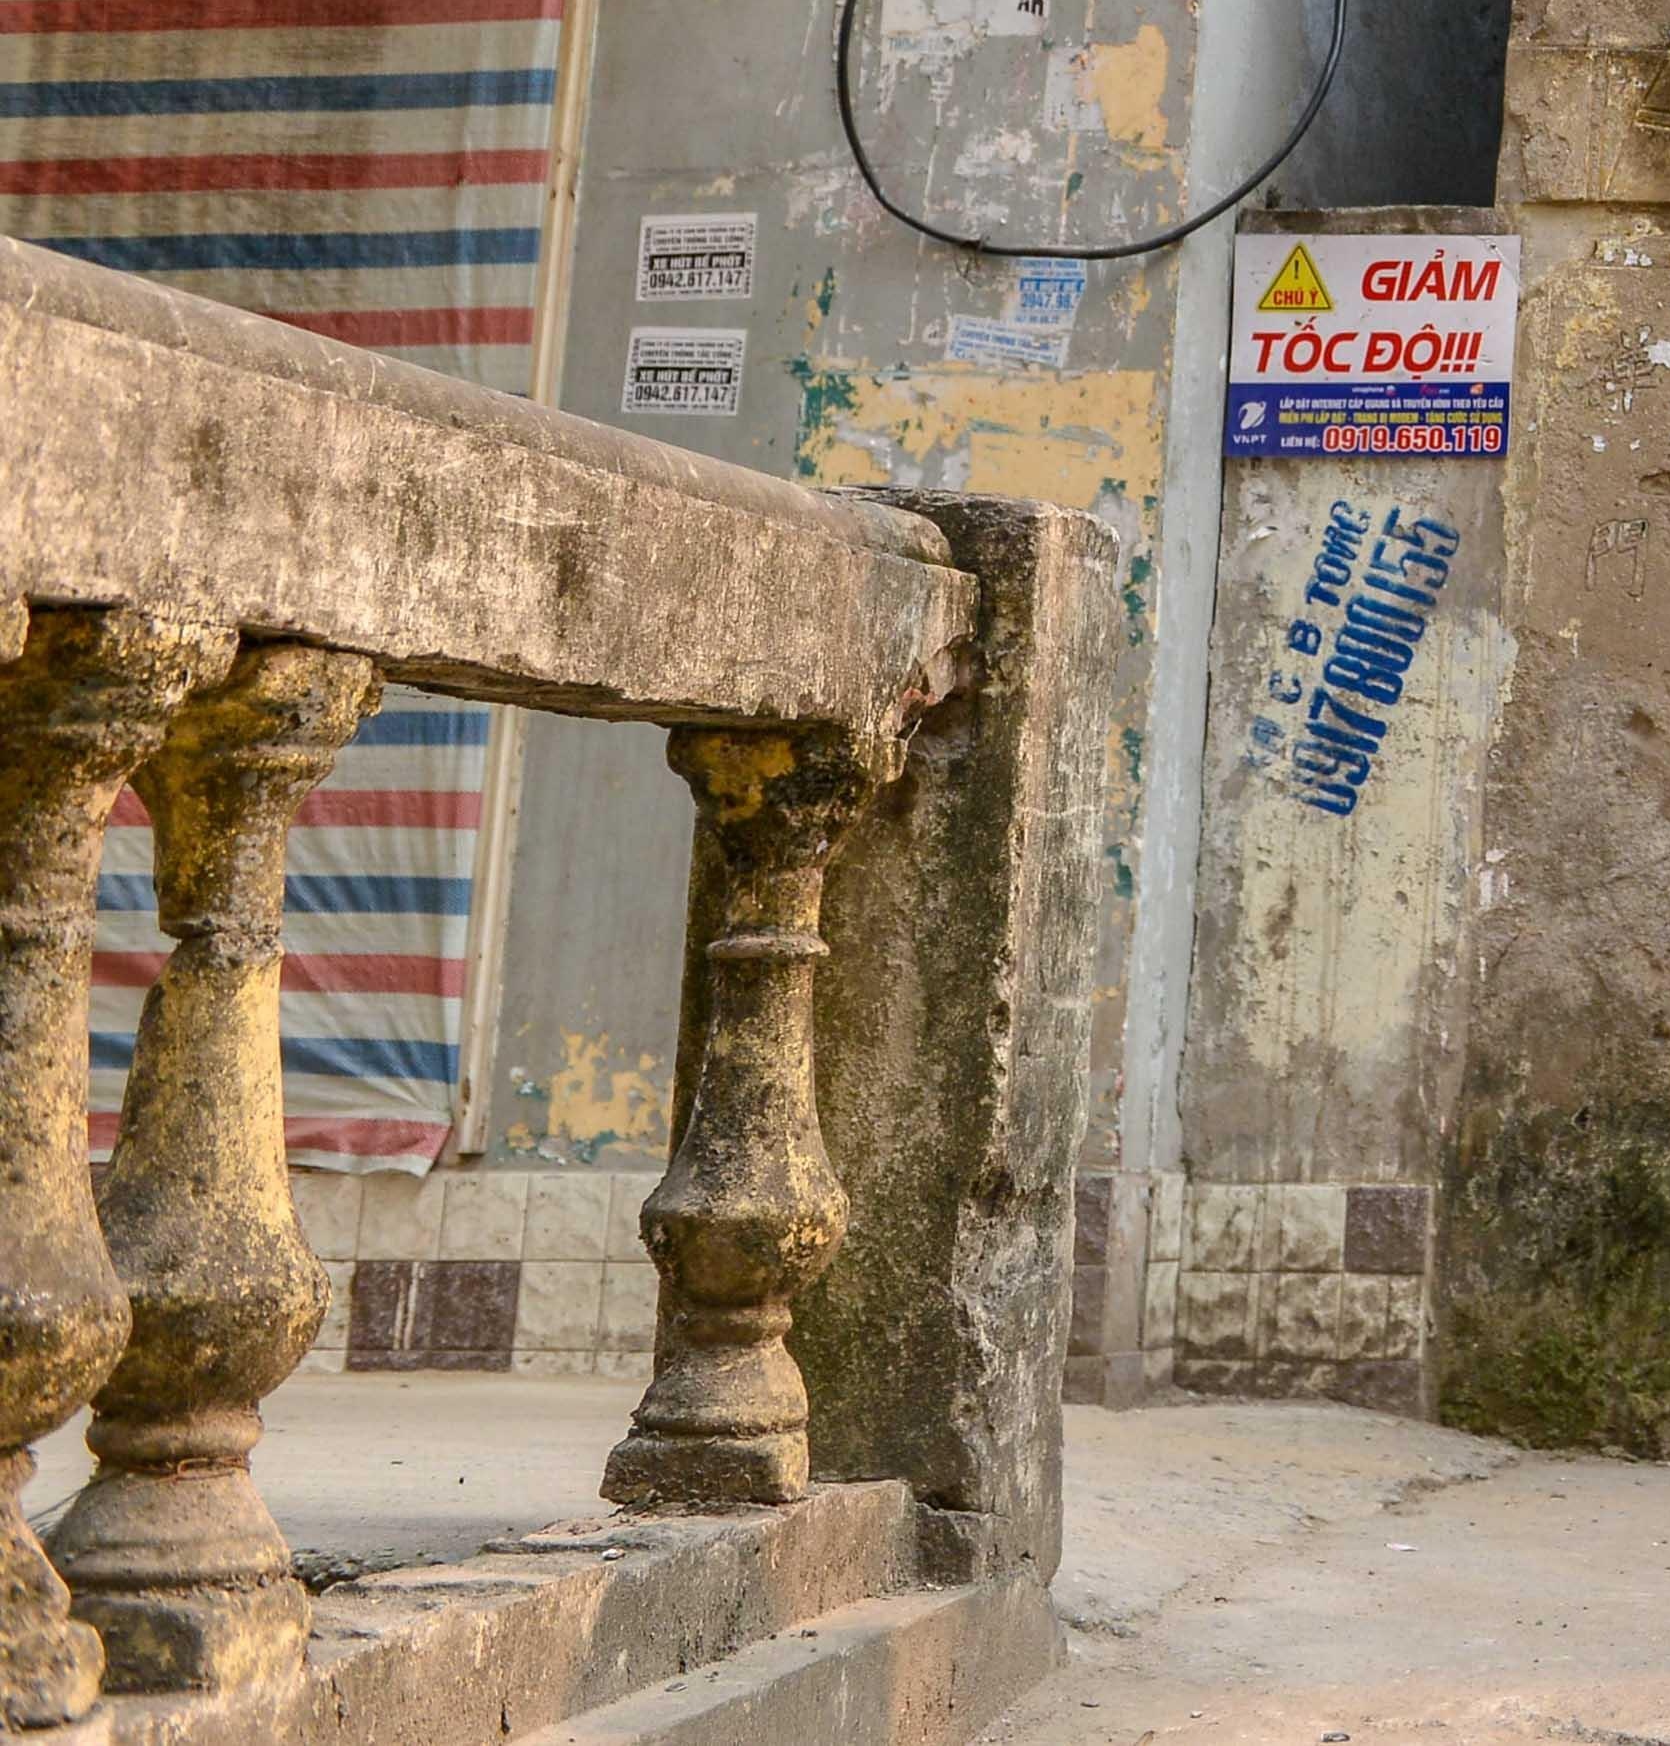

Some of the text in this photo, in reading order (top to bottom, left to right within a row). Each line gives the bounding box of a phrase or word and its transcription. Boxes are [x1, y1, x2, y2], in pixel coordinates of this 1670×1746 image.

[1360, 248, 1502, 302] GIẢM
[1272, 288, 1304, 307] CHÚ
[1251, 316, 1483, 380] TỐC ĐỘ!!!
[1233, 434, 1268, 445] VNPT
[1323, 425, 1502, 452] 0919.650.119
[1287, 618, 1322, 657] B
[1292, 505, 1461, 817] 0917800155
